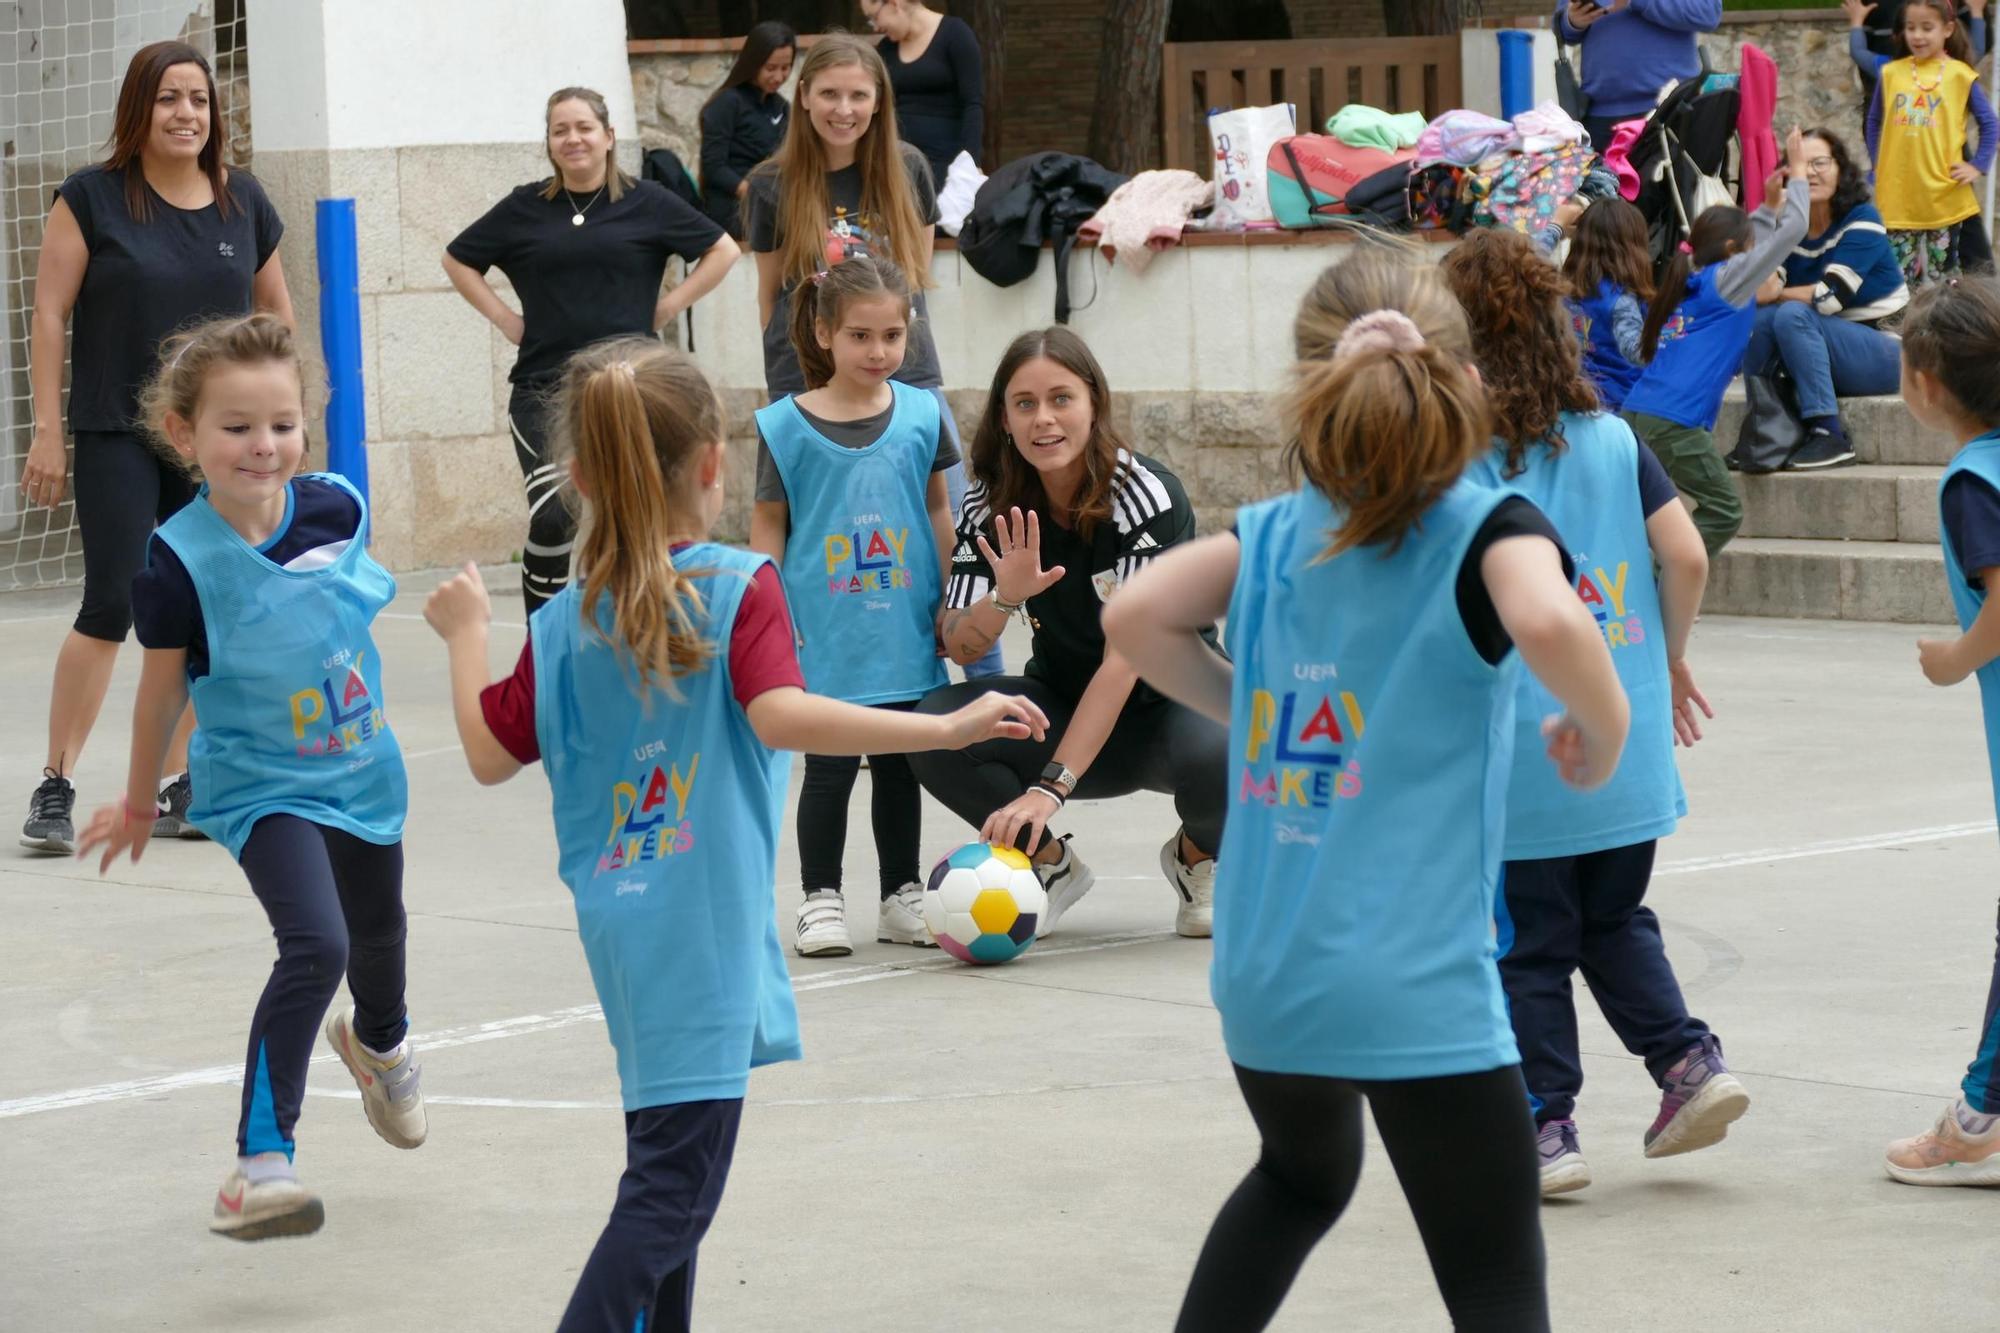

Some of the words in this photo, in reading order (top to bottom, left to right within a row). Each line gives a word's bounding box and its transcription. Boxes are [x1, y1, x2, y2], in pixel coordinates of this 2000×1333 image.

[853, 514, 882, 526] UEFA
[825, 527, 909, 576] PLAY
[952, 554, 977, 563] adidas
[828, 568, 912, 596] MAKERS
[1577, 561, 1629, 622] AY
[296, 707, 386, 759] MAKER
[606, 752, 700, 847] PLAY
[1240, 759, 1363, 809] MKES
